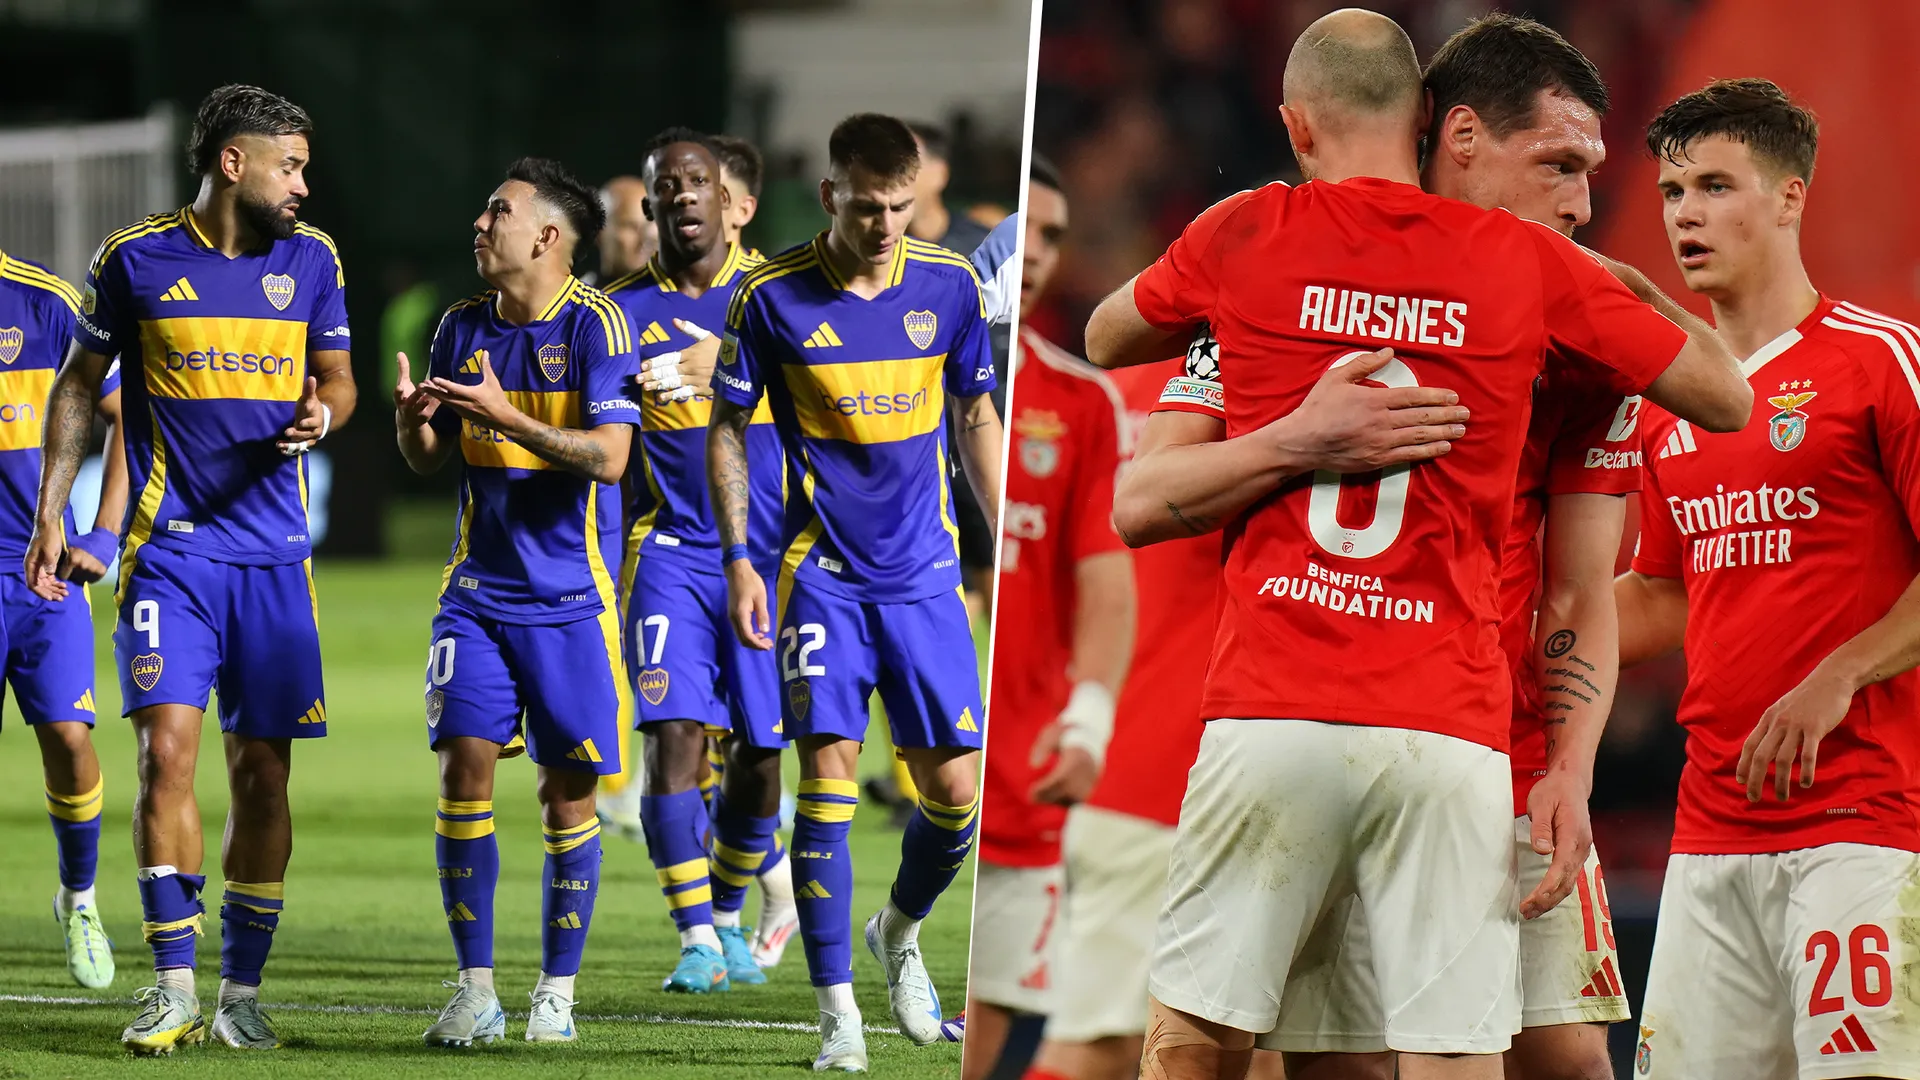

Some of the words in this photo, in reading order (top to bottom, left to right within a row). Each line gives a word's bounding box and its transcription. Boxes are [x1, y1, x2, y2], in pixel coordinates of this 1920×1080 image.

[266, 286, 291, 294] CABJ
[908, 323, 933, 333] CABJ
[1299, 285, 1468, 348] AURSNES
[165, 346, 294, 376] betsson
[542, 356, 567, 365] CABJ
[1584, 448, 1642, 470] Betano
[1667, 482, 1820, 536] Emirates
[1307, 562, 1384, 592] BENFICA
[1258, 576, 1434, 623] FOUNDATION
[133, 600, 160, 648] 9
[636, 614, 670, 667] 17
[782, 623, 826, 682] 22
[135, 665, 159, 675] CABJ
[552, 878, 589, 892] CABJ
[1805, 924, 1893, 1017] 26
